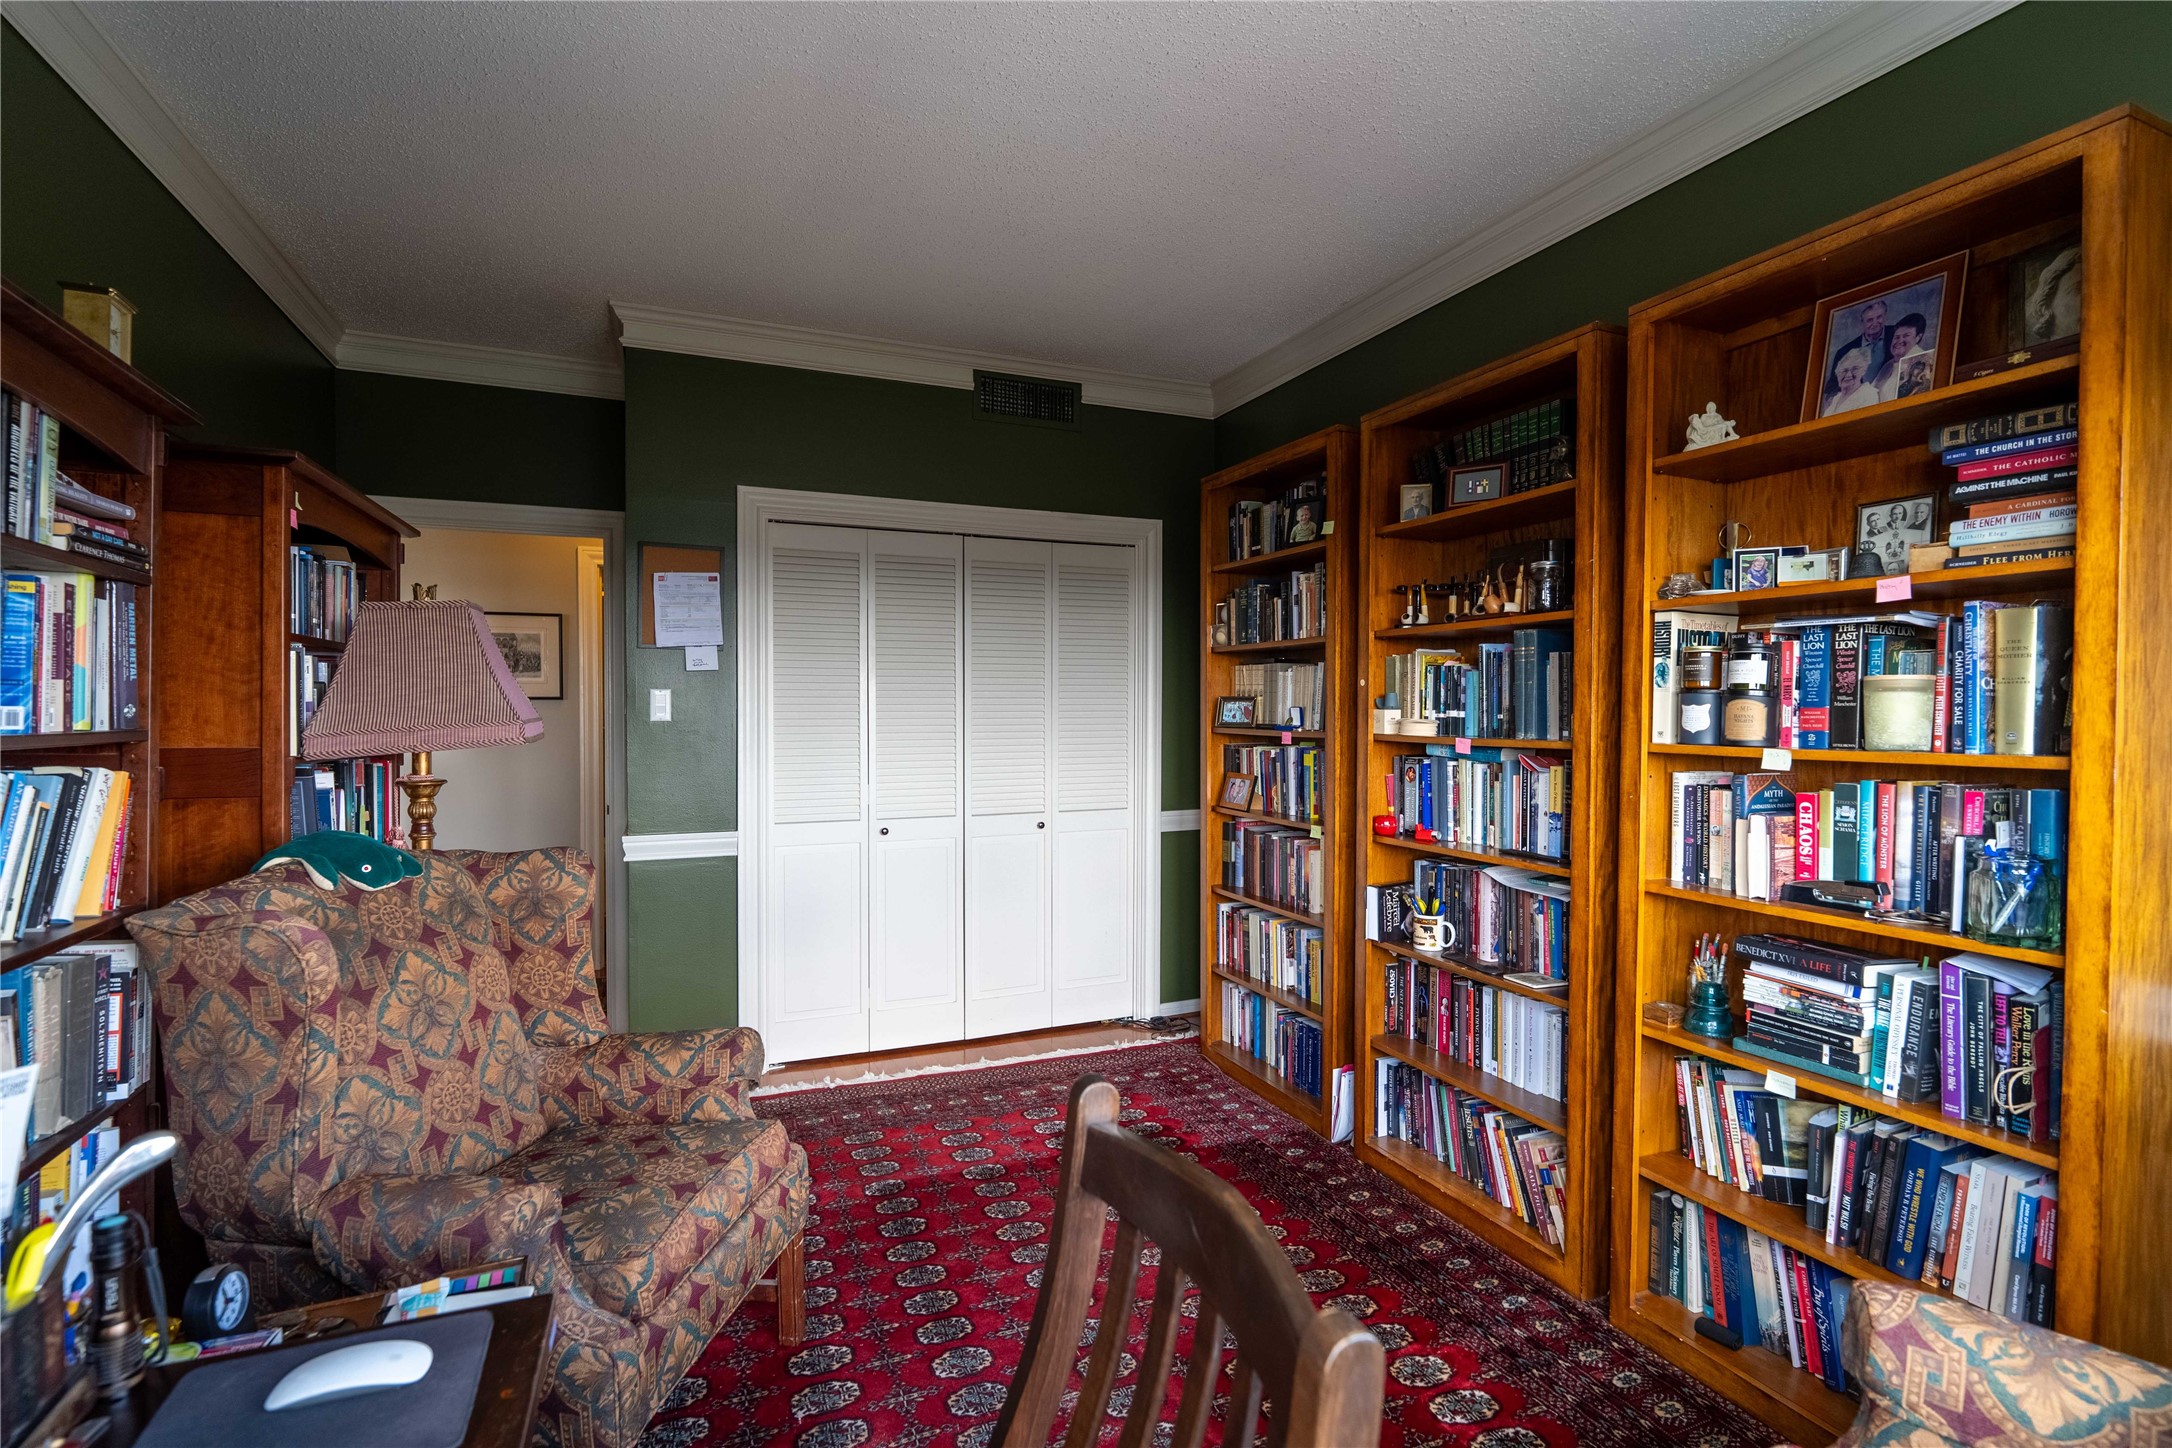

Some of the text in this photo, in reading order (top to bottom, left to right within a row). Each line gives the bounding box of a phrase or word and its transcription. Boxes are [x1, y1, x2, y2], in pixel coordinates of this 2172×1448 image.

[1975, 447, 1989, 456] THE
[1992, 441, 2024, 453] CHURCH
[2037, 435, 2052, 445] THE
[1993, 453, 2067, 471] THE CATHOLIC
[1955, 473, 2049, 494] AGAINST THE MACHINE
[2015, 498, 2058, 509] CARDINAL
[1962, 511, 2042, 530] THE ENEMY WITHIN
[1803, 634, 1824, 642] LAST
[1835, 632, 1858, 640] LAST
[1838, 624, 1857, 632] THE
[1864, 624, 1915, 636] THE LAST LION
[1802, 642, 1825, 650] LION
[1835, 641, 1858, 649] LION
[1964, 611, 1973, 676] CHRISTIANITY
[129, 647, 137, 681] METAL
[1954, 650, 1964, 725] CHARITY FOR SALE
[1763, 790, 1784, 798] MYTH
[53, 808, 73, 874] Democratic Faith
[1799, 801, 1813, 854] CHAOS
[1881, 826, 1888, 836] OF
[1392, 891, 1400, 926] Marcel
[1736, 943, 1778, 961] BENEDICT
[1810, 962, 1832, 974] LIFE
[1946, 1003, 1955, 1014] The
[1995, 994, 2006, 1045] LEFT TO TELL
[2023, 1007, 2035, 1030] Love
[1907, 995, 1924, 1058] ENDURANCE
[1946, 1014, 1956, 1039] Literary
[2011, 1006, 2022, 1066] Walker Percy
[97, 1009, 105, 1083] SOLZHENITSYN
[1946, 1039, 1956, 1058] Guide
[1948, 1077, 1956, 1092] Bible
[1527, 1169, 1537, 1192] SAINT
[1533, 1194, 1542, 1217] PIUS
[1896, 1170, 1914, 1242] JORDAN PETERSON
[1840, 1194, 1852, 1231] MATT WALSH
[1903, 1168, 1925, 1253] WE WHO WRESTLE WITH GOD
[1932, 1185, 1949, 1232] TEMPLAR ENIGMA
[1951, 1188, 1964, 1230] FRANKENSTEIN
[1966, 1203, 1978, 1241] Bearing False
[1710, 1248, 1717, 1257] OF
[1671, 1267, 1680, 1296] Dictionary
[1711, 1259, 1720, 1283] SIMPLE
[1714, 1284, 1722, 1306] FOOD
[1801, 1270, 1812, 1318] COMING APART
[1812, 1284, 1833, 1353] Bay Spirits
